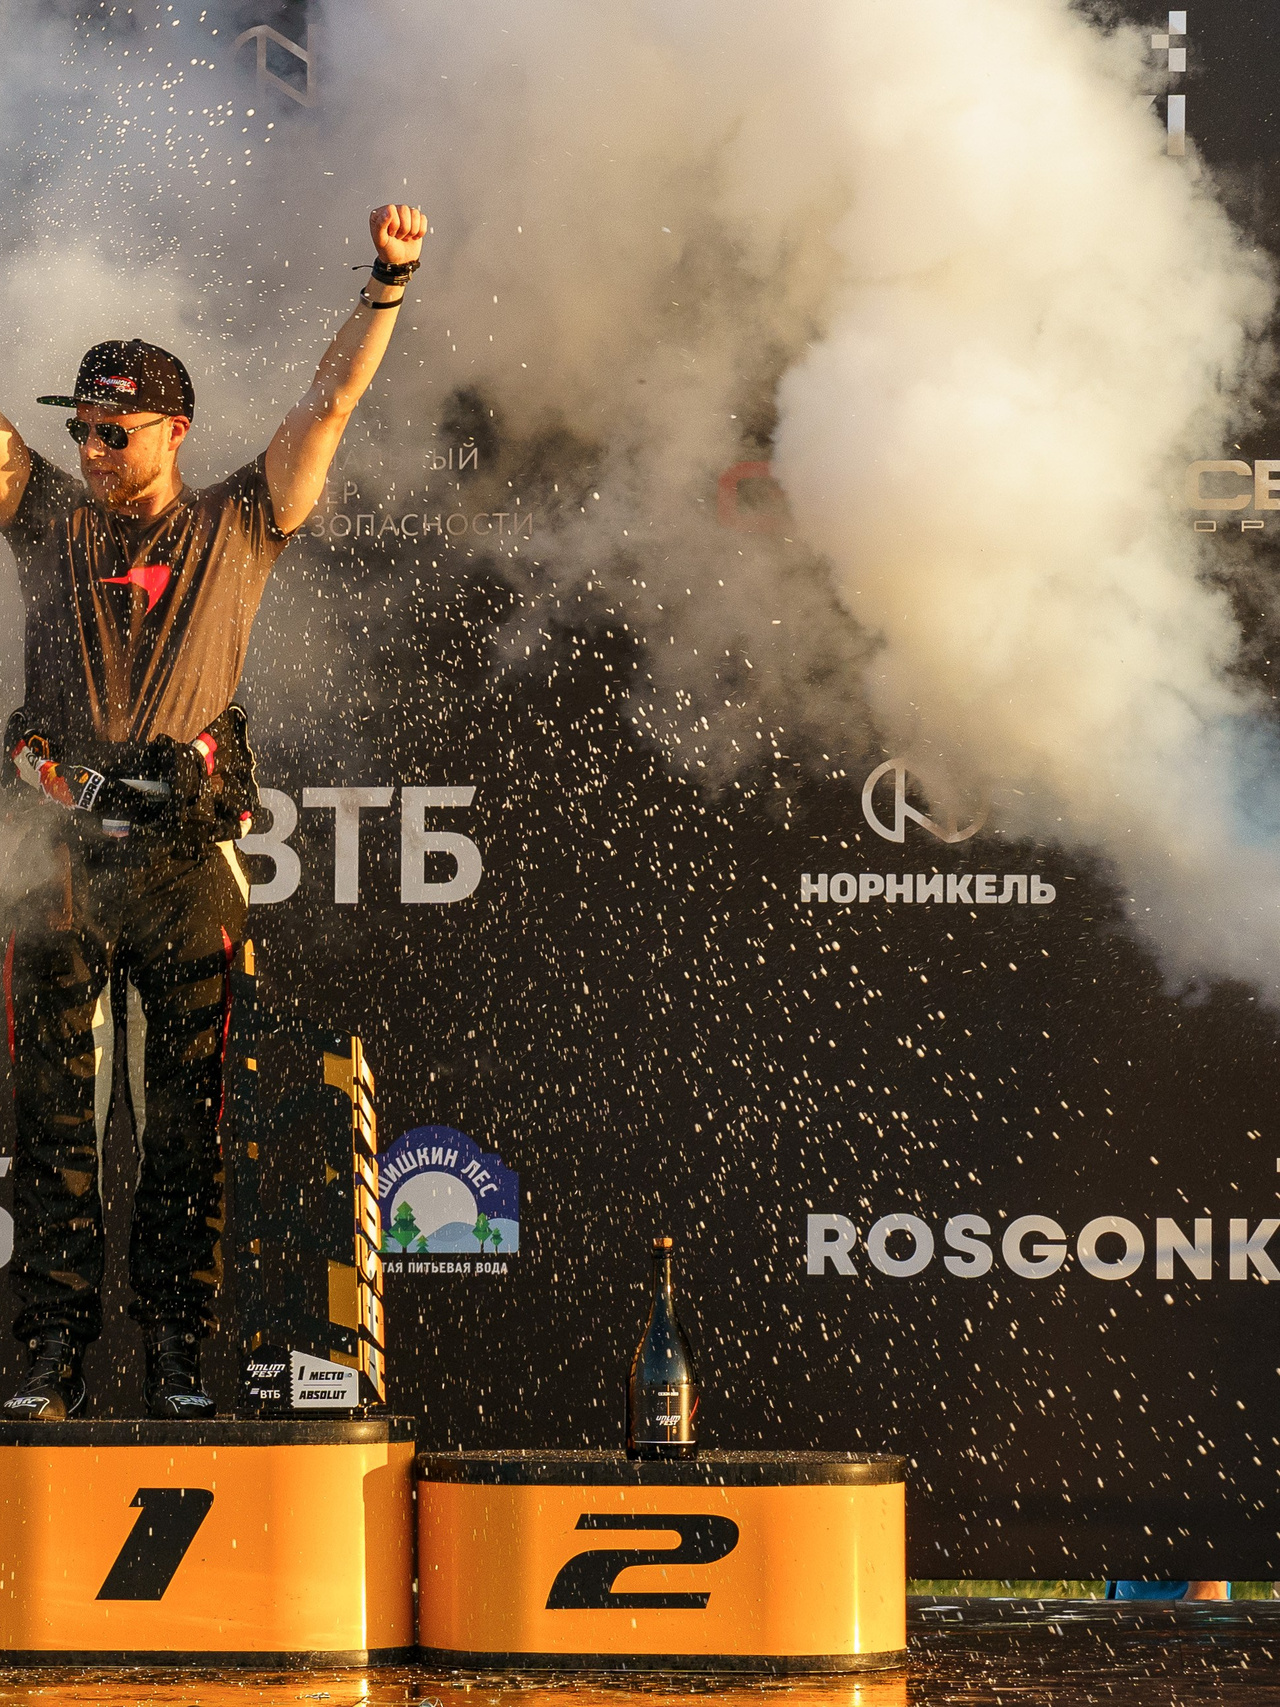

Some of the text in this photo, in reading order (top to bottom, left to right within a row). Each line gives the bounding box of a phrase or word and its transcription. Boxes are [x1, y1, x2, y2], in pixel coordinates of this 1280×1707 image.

[300, 513, 534, 538] ЗОПАСНОСТИ
[235, 786, 483, 904] ВТБ
[800, 873, 1057, 904] НОРНИКЕЛЬ
[378, 1146, 498, 1199] ШИШКИН ЛЕС
[807, 1213, 1280, 1281] ROSGONK
[408, 1261, 471, 1274] ПИТЬЕВАЯ
[476, 1261, 508, 1275] ВОДА
[251, 1370, 281, 1378] FEST
[308, 1371, 345, 1381] МЕСТО
[260, 1389, 282, 1399] ВТБ
[298, 1390, 348, 1400] ABSOLUT
[95, 1487, 216, 1601] 1
[545, 1513, 740, 1610] 2
